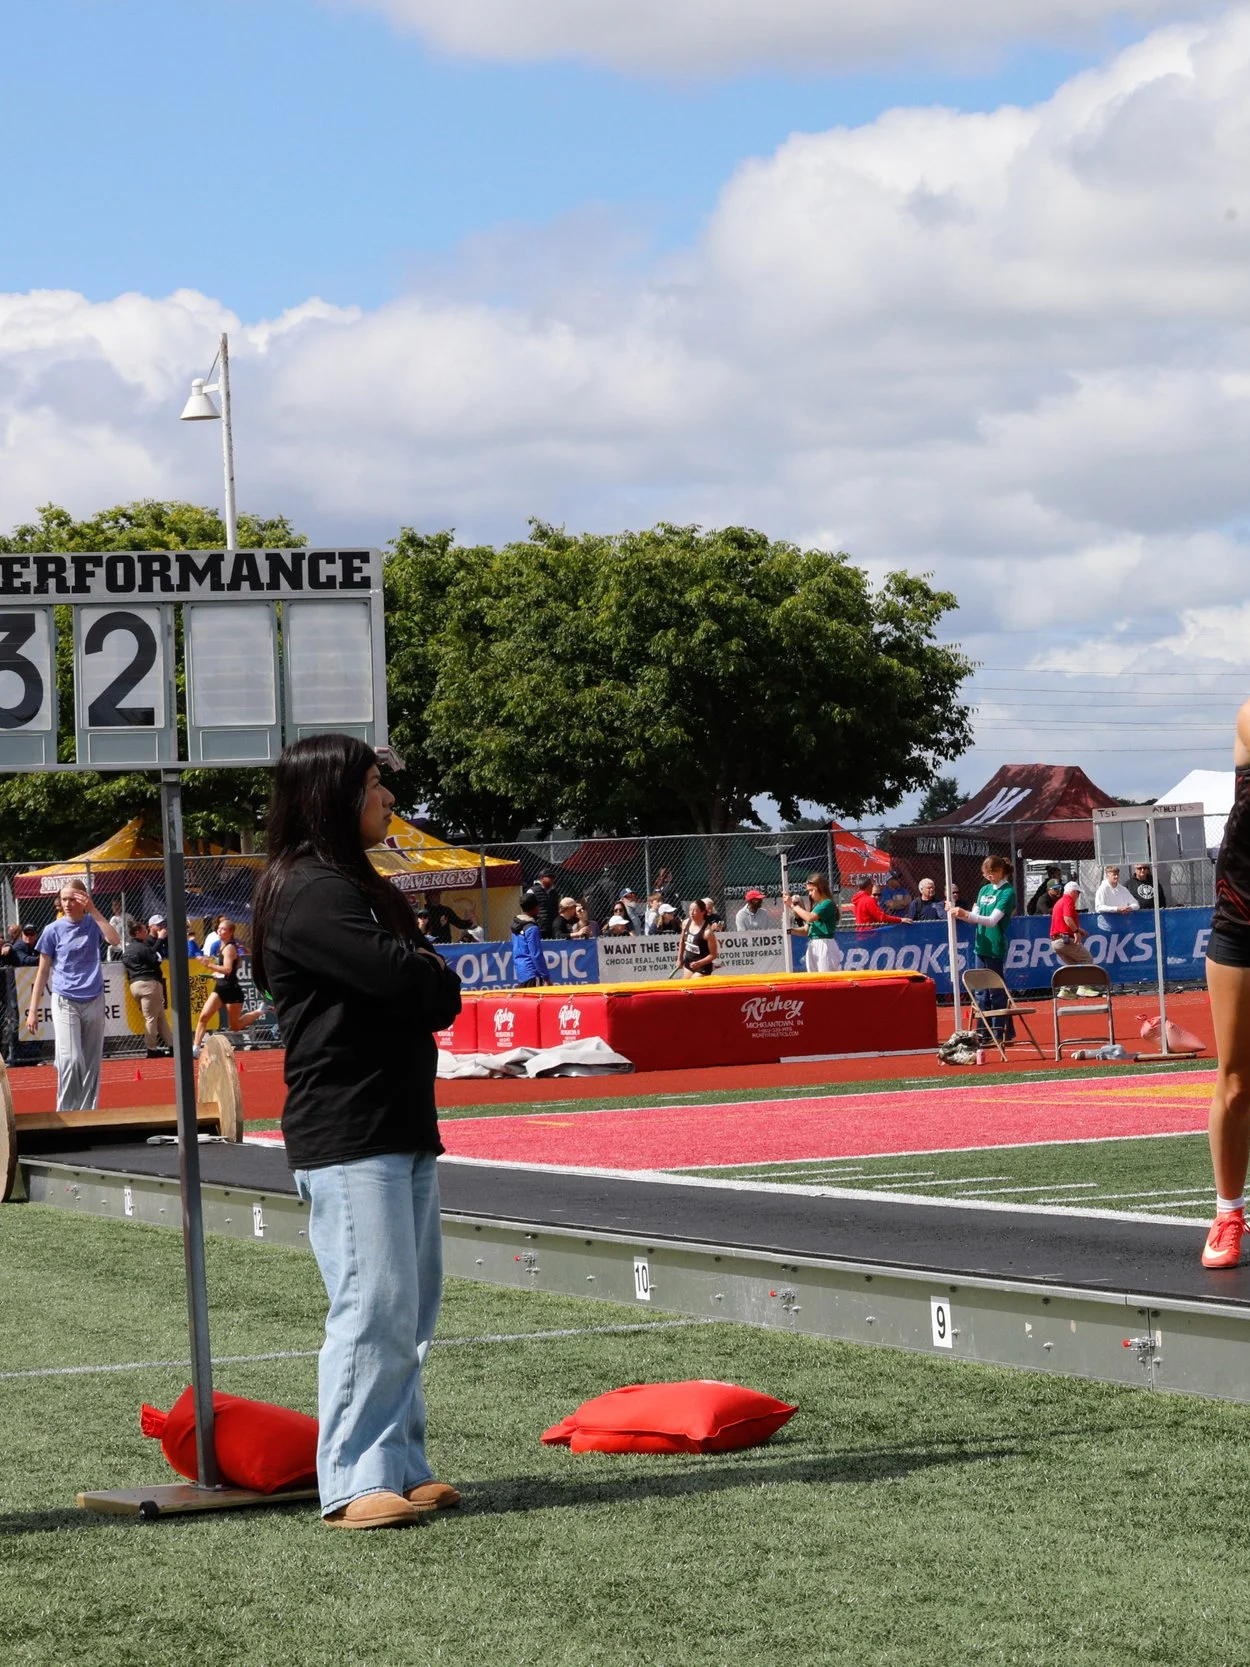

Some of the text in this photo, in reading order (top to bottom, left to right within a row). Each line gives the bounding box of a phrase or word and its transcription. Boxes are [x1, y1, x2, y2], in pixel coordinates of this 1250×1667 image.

[0, 551, 371, 594] ERFORMANCE
[85, 611, 157, 727] 2
[604, 943, 637, 955] WANT
[640, 942, 660, 954] THE
[663, 941, 681, 953] BES
[718, 937, 748, 949] YOUR
[751, 935, 783, 947] KIDS?
[605, 957, 634, 966] CHOOSE
[742, 949, 782, 958] TURFGRASS
[843, 942, 970, 974] ROOKS
[1005, 933, 1156, 968] BROKS
[456, 948, 588, 984] OLYPIC
[633, 965, 647, 973] FOR
[649, 964, 666, 972] YOUR
[732, 959, 754, 967] FIELDS
[741, 995, 804, 1023] Richey
[635, 1264, 648, 1293] 10
[937, 1306, 945, 1339] 9
